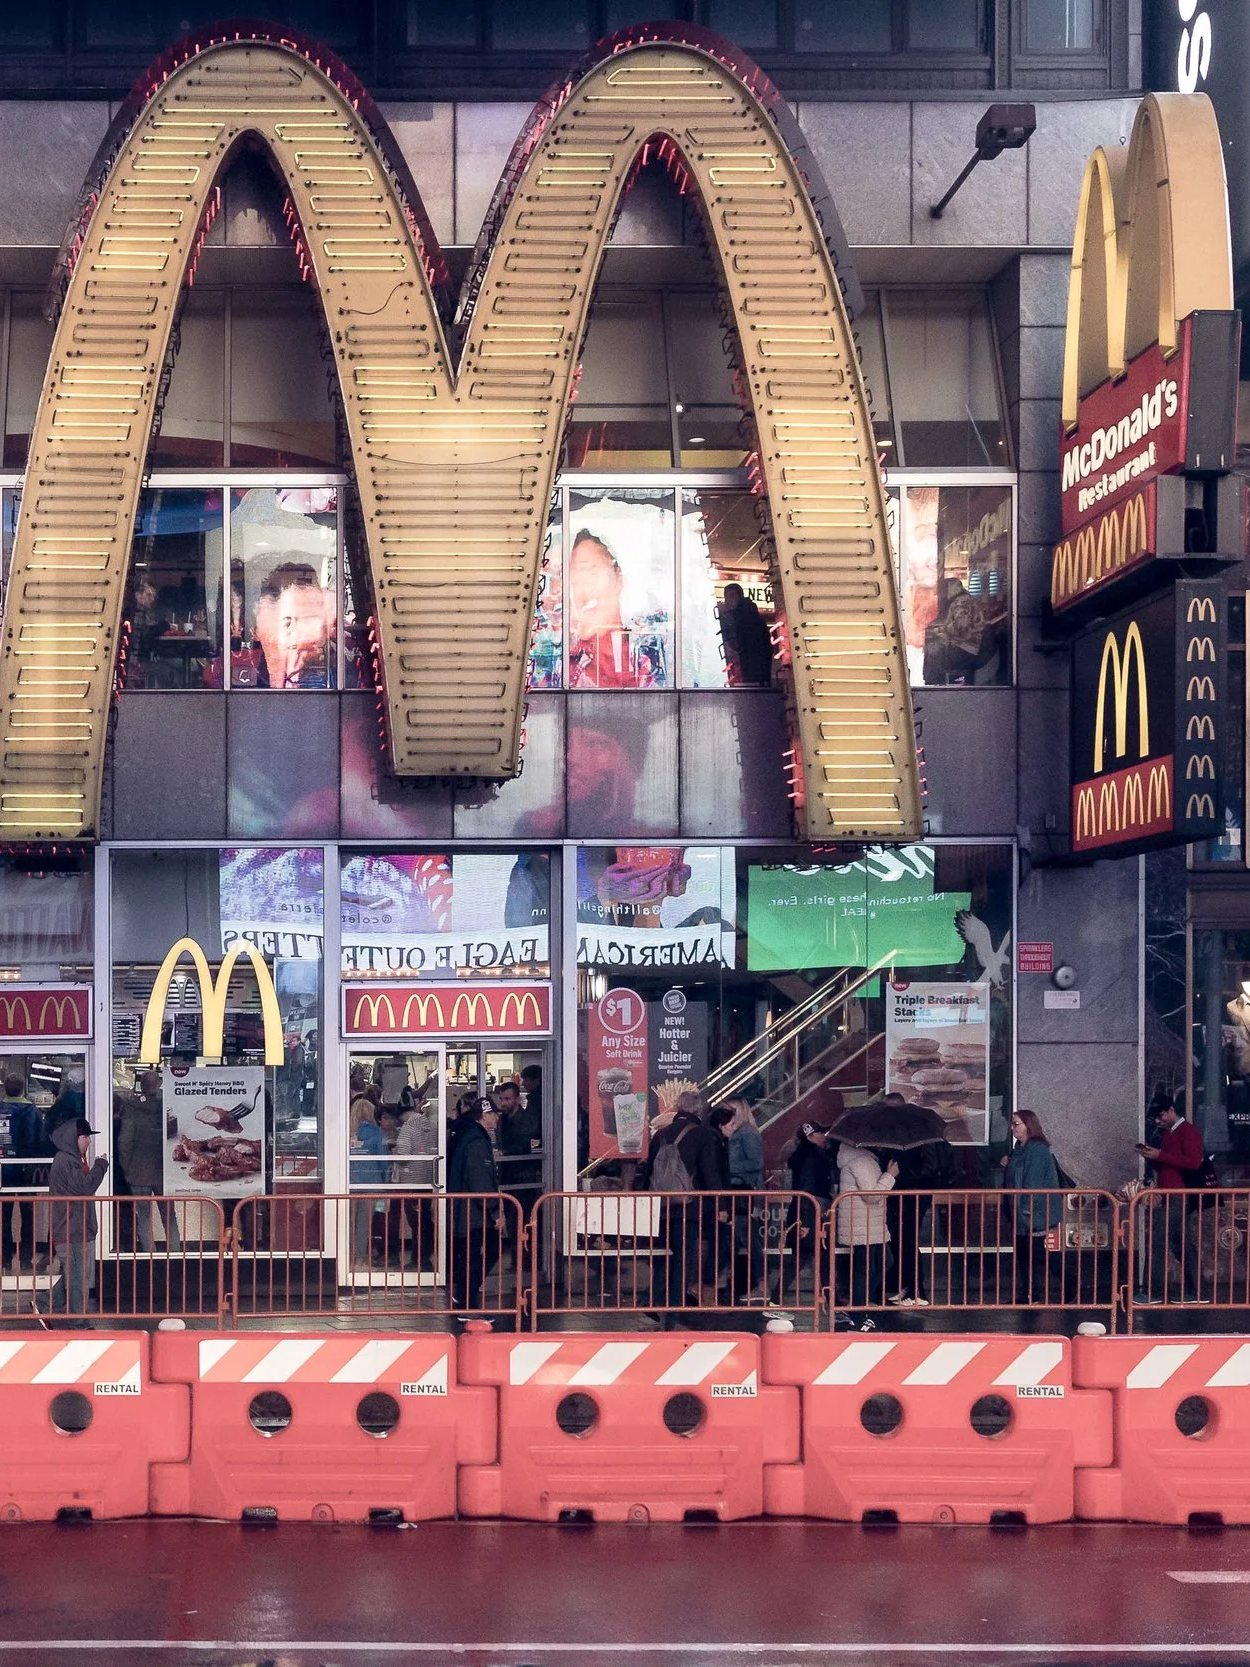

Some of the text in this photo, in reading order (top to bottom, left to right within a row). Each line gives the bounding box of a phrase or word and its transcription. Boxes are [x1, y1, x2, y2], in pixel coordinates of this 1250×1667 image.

[1062, 378, 1178, 492] McDonald's
[1078, 441, 1157, 512] Restaurant
[1020, 962, 1051, 970] BUILDING
[894, 994, 980, 1007] Triple Breakfast
[606, 997, 632, 1026] $1
[894, 1007, 932, 1017] Stacks
[664, 1016, 685, 1026] NEW!
[659, 1028, 690, 1039] Hotter
[601, 1035, 646, 1049] Any Size
[670, 1039, 679, 1051] &
[605, 1049, 642, 1058] Soft Drink
[657, 1051, 692, 1062] Juicier
[174, 1087, 247, 1096] Glazed Tenders
[96, 1384, 139, 1393] RENTAL
[402, 1384, 445, 1394] RENTAL
[712, 1386, 755, 1395] RENTAL
[1020, 1387, 1063, 1396] RENTAL
